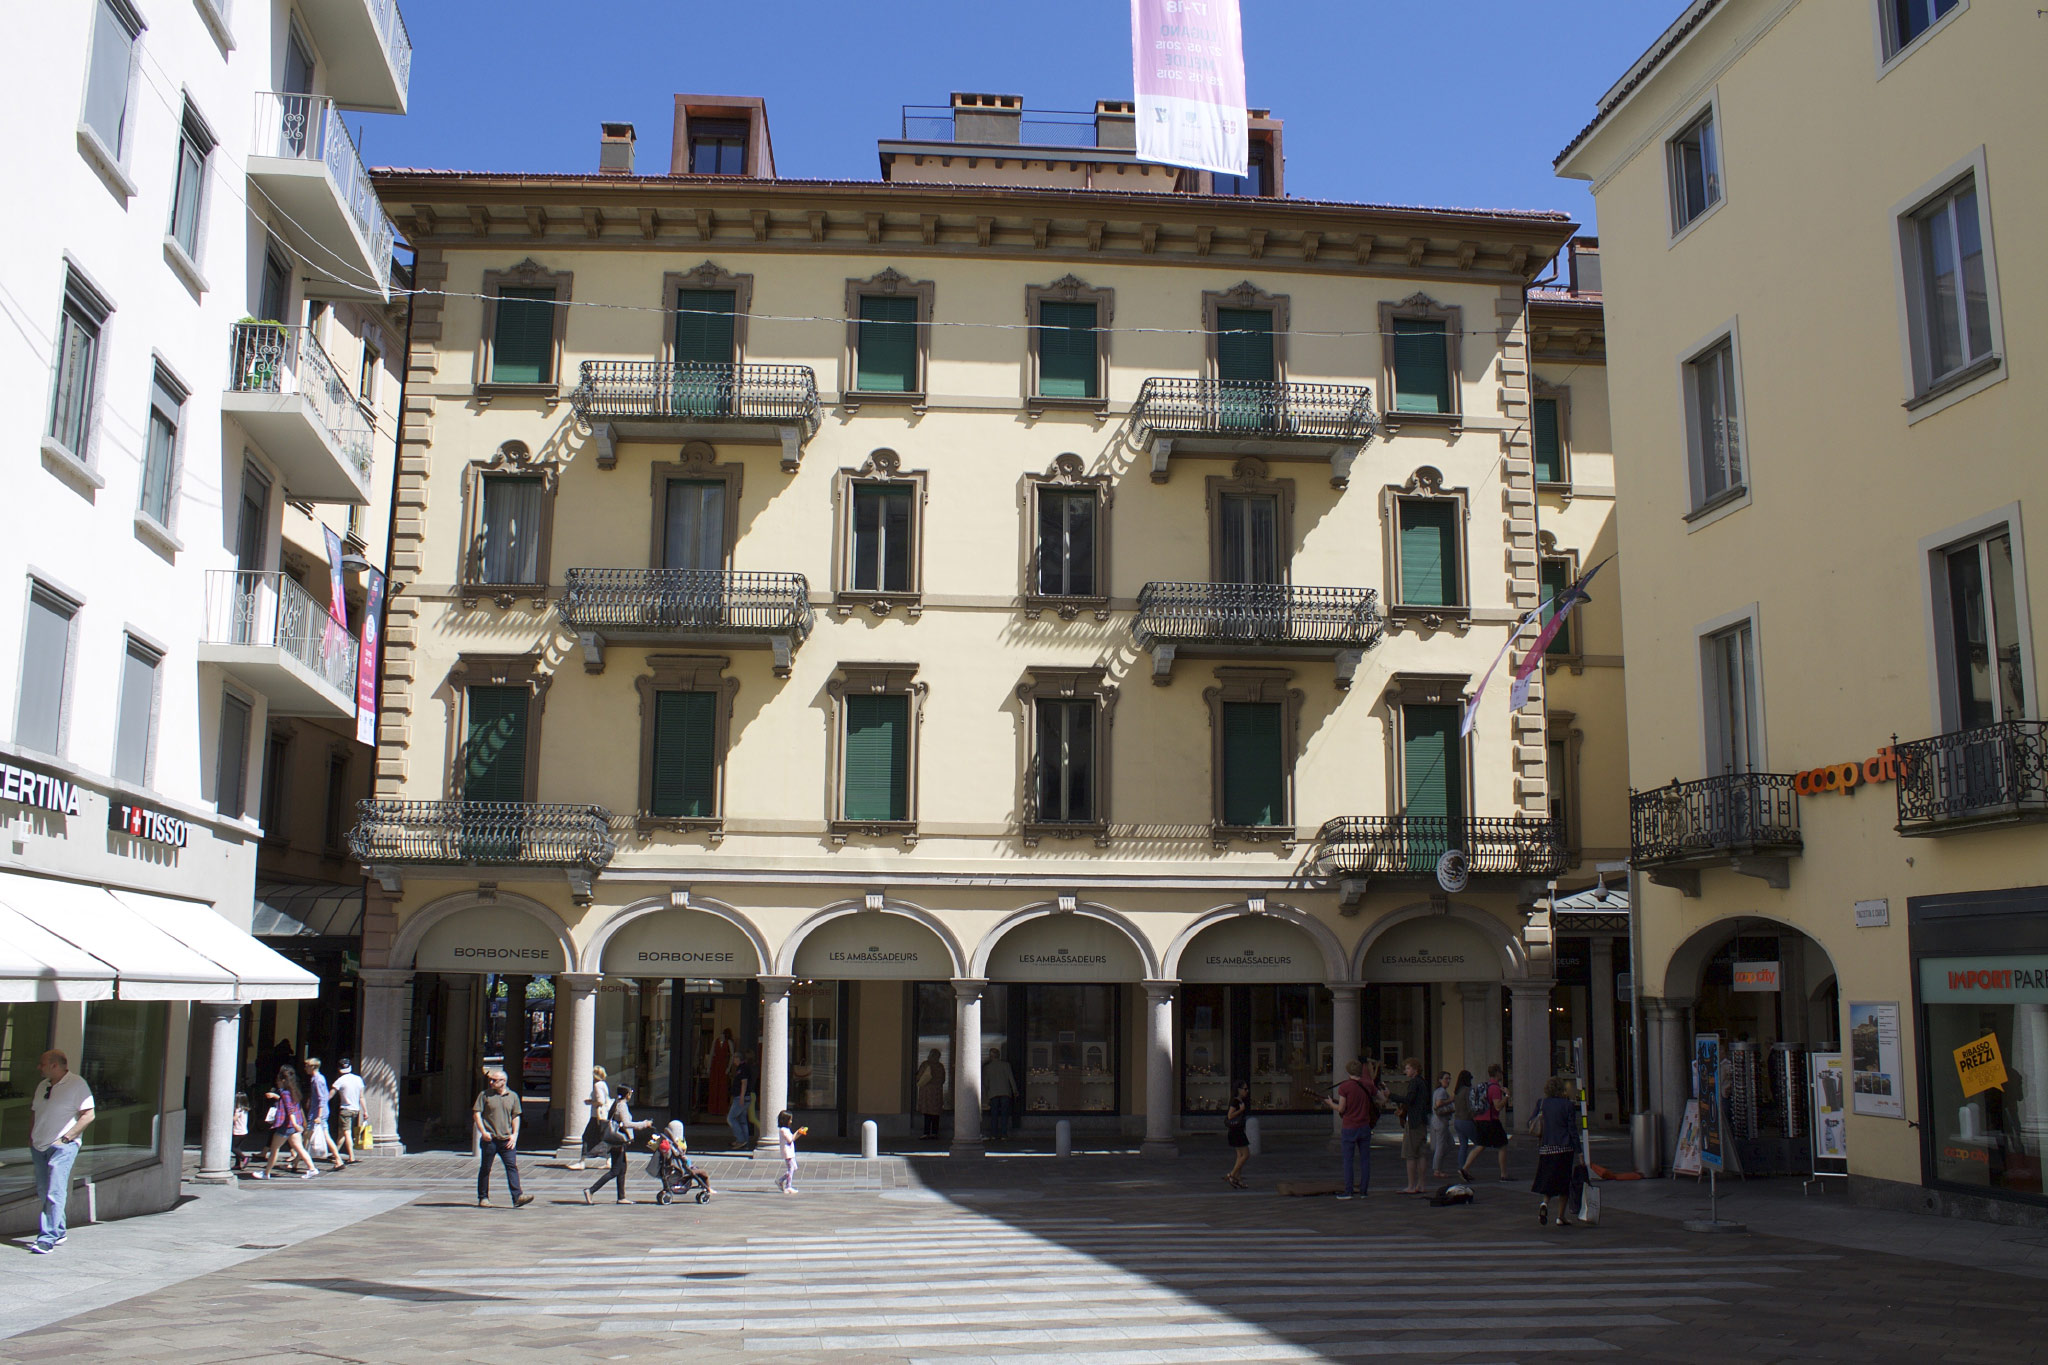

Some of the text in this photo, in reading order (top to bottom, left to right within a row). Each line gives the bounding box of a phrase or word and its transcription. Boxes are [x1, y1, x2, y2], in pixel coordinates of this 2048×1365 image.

[1794, 762, 1859, 796] coop
[454, 947, 549, 959] BORBONESE
[638, 951, 734, 962] BORBONESE
[829, 952, 918, 961] LES AMBASSADEURS
[1019, 954, 1106, 963] LES AMBASSADEURS
[1206, 956, 1291, 964] LES AMBASSADEURS
[1382, 955, 1464, 964] LES AMBASSADEURS
[1948, 969, 2012, 990] IMPORT
[1962, 1041, 1990, 1058] RIBASSO
[1960, 1048, 1995, 1073] PREZZI
